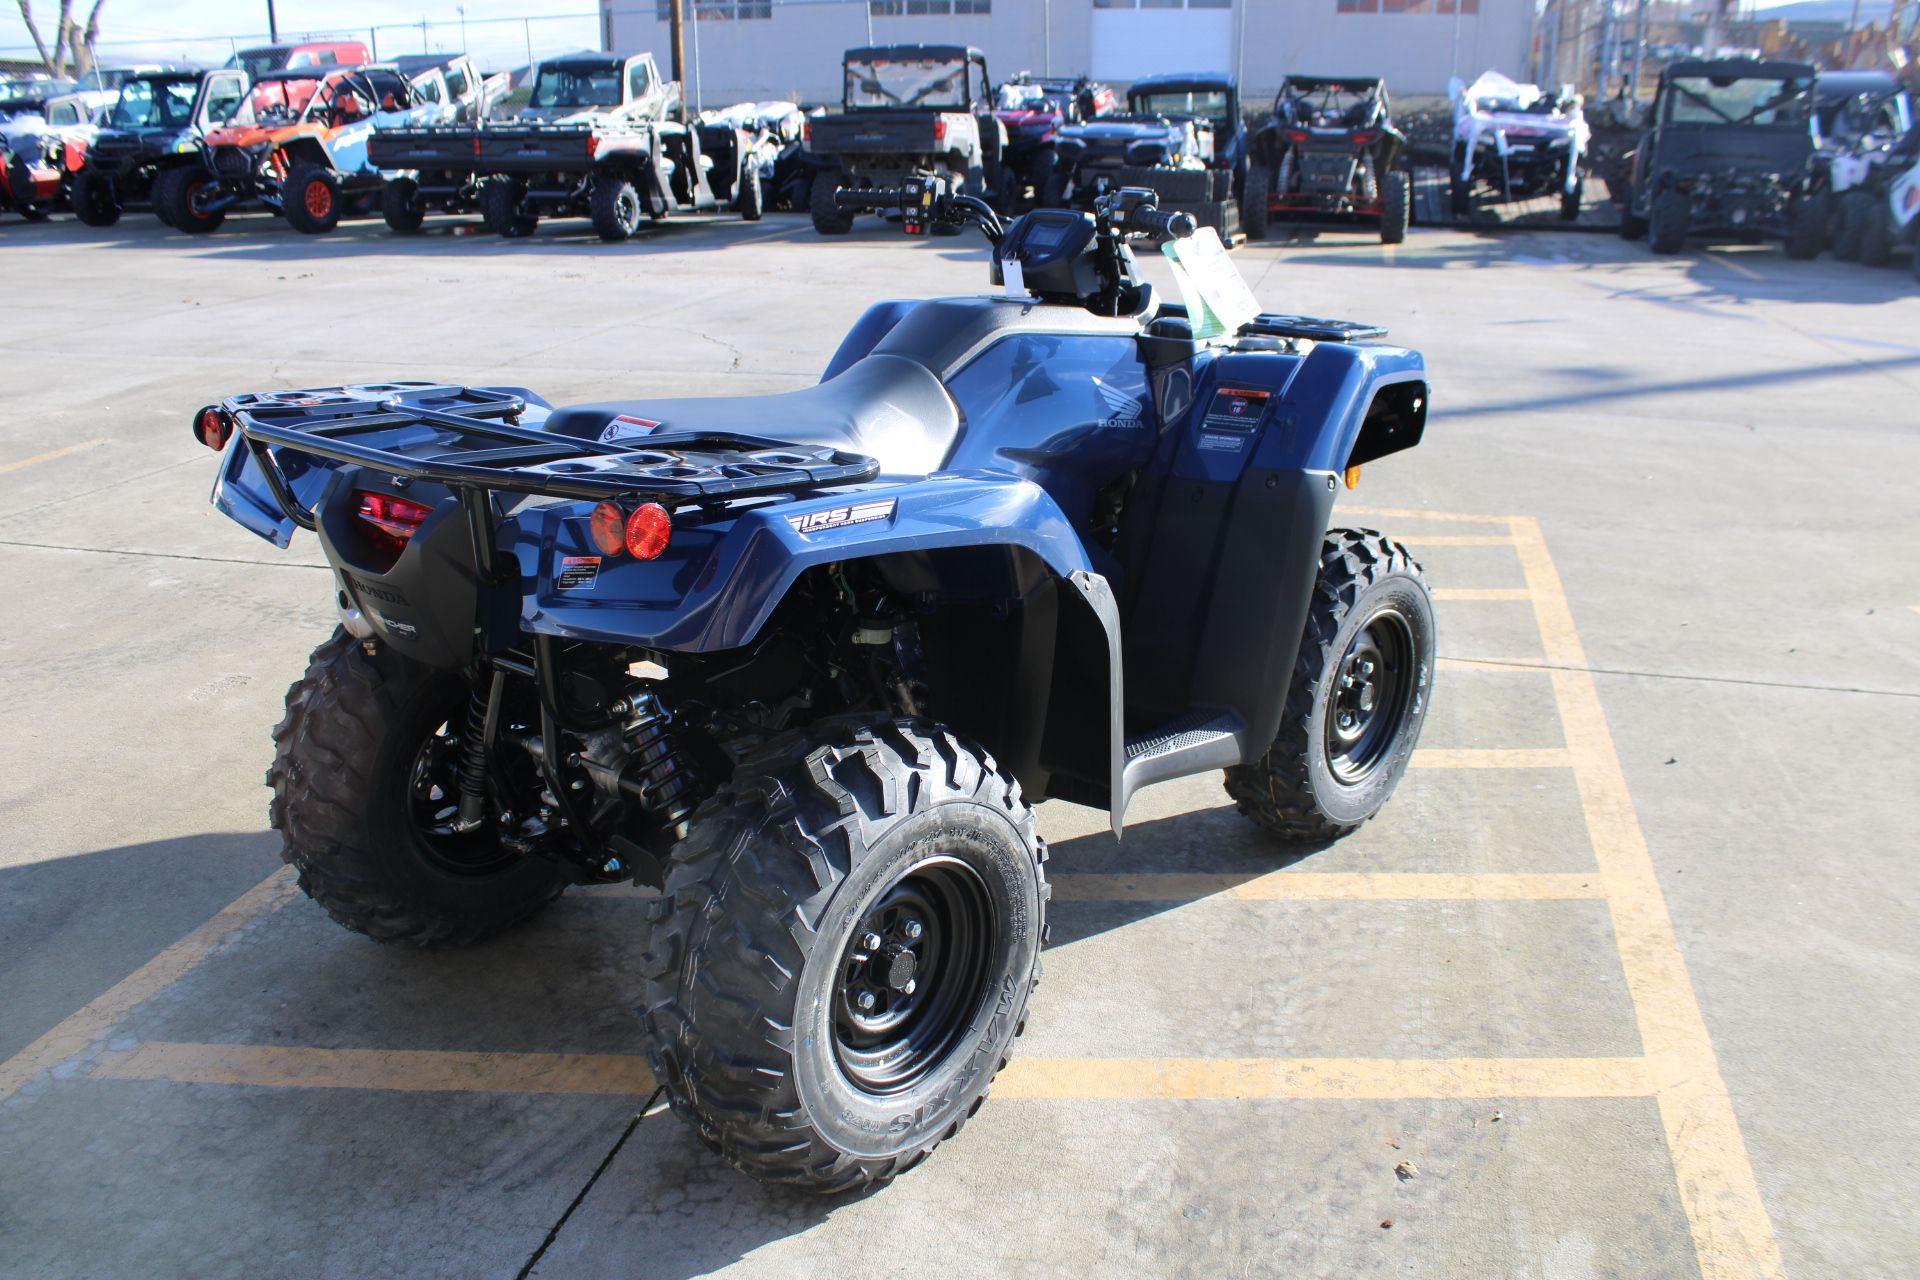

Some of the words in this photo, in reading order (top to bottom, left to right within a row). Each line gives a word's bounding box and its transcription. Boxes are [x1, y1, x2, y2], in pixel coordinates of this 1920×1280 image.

[1232, 406, 1242, 414] 16
[1098, 418, 1144, 429] HONDA
[801, 507, 853, 528] IRS
[354, 579, 410, 607] HONDA
[888, 973, 1017, 1134] MAXXIS
